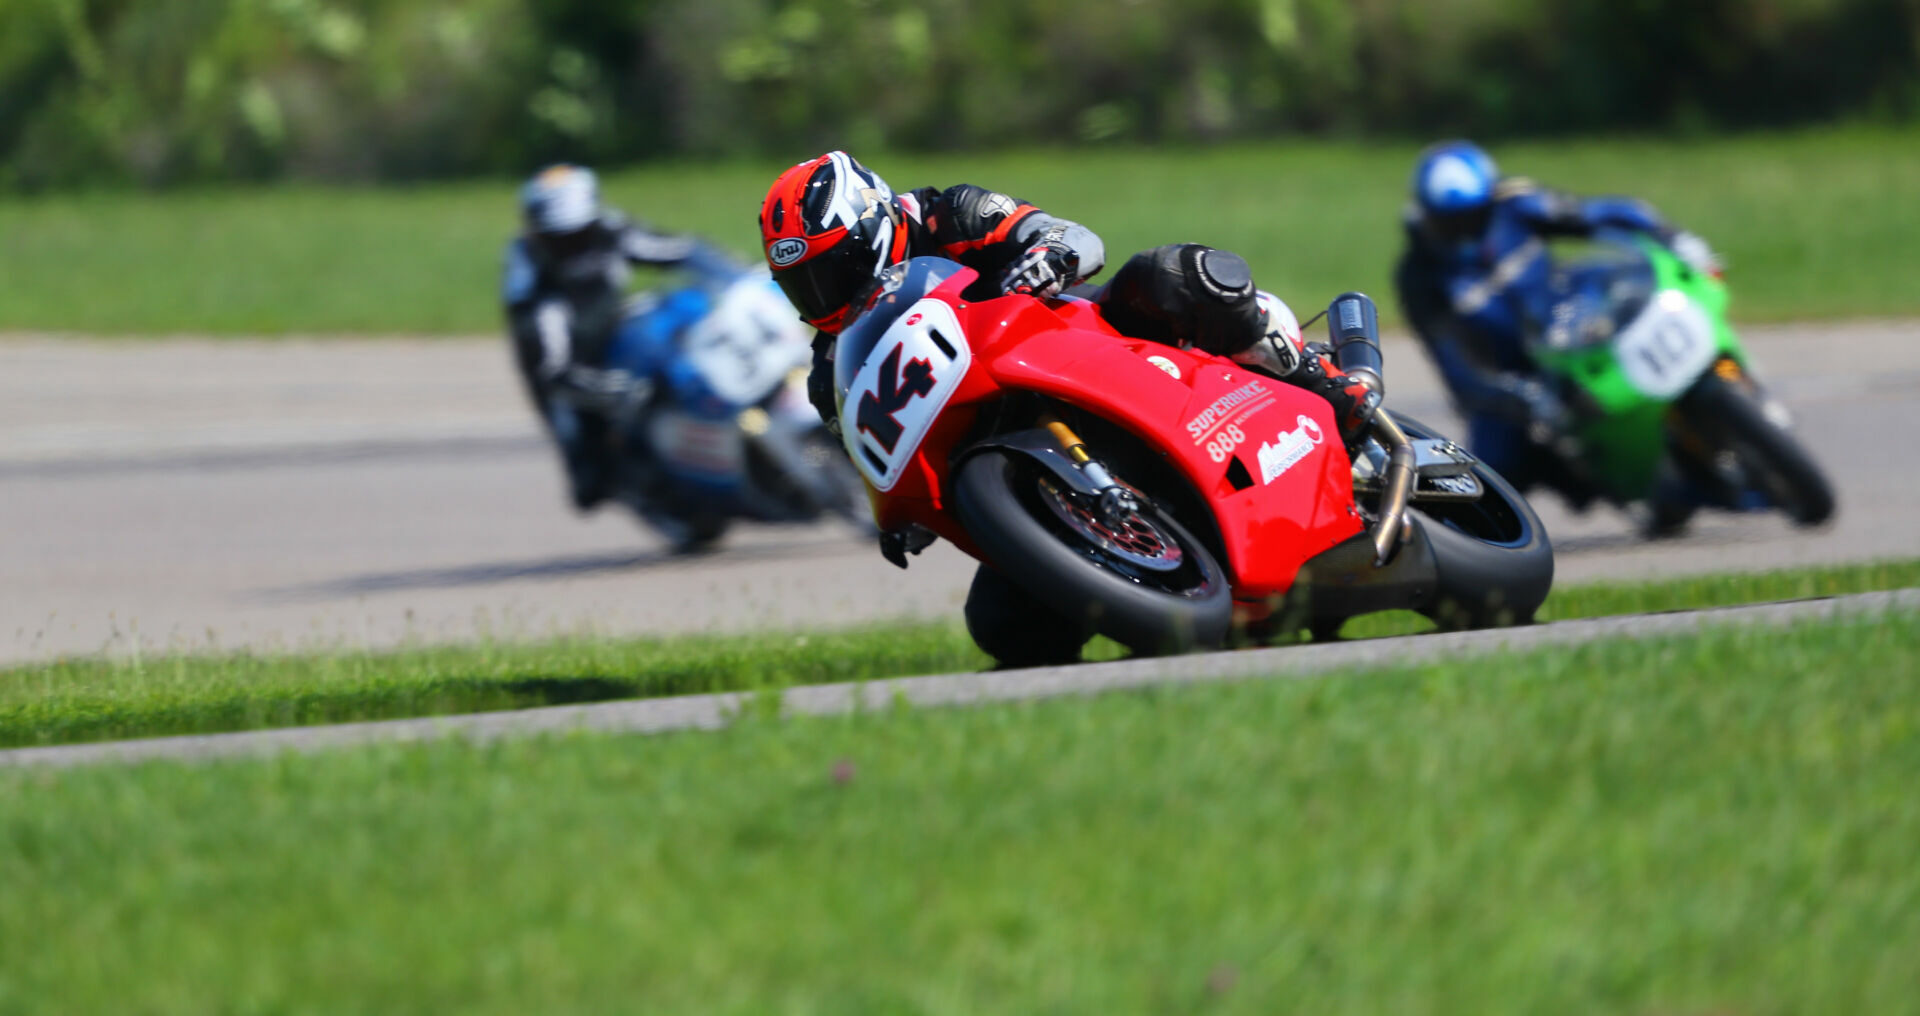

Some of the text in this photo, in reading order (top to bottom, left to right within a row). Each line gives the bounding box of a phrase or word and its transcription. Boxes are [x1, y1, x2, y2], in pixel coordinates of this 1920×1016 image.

[773, 242, 800, 260] Arai
[1639, 318, 1697, 379] 10
[857, 341, 938, 457] 14
[1186, 380, 1267, 439] SUPERBIKE
[1206, 423, 1246, 463] 888
